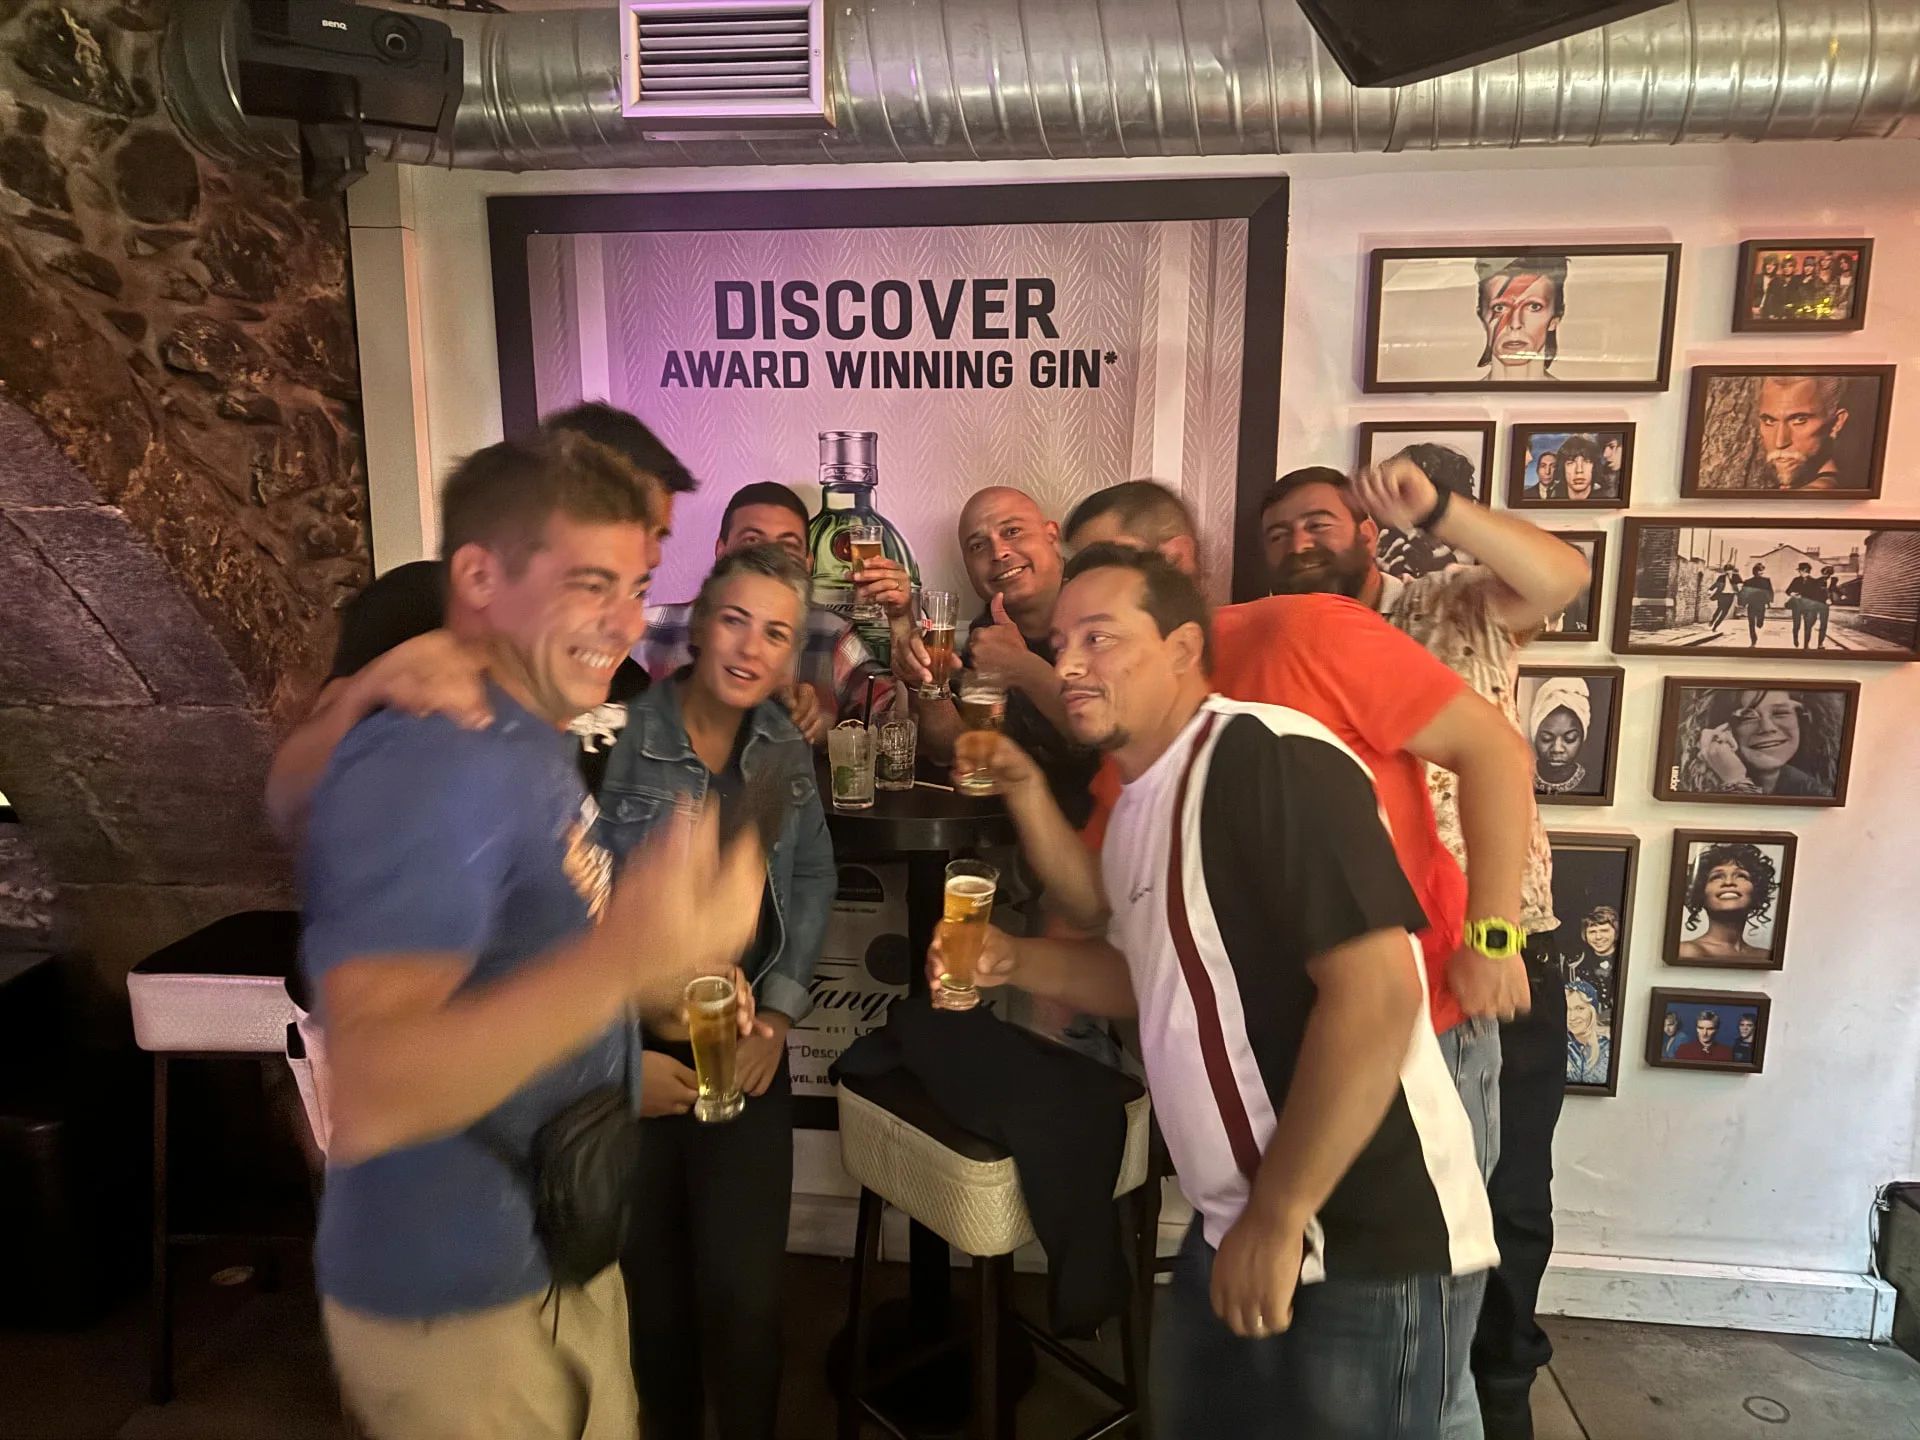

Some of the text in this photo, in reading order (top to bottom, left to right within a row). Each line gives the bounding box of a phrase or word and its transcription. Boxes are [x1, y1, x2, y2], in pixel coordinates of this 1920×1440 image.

[714, 278, 1059, 340] DISCOVER
[660, 350, 809, 388] AWARD
[825, 350, 1012, 388] WINNING
[808, 975, 903, 1022] Tanq
